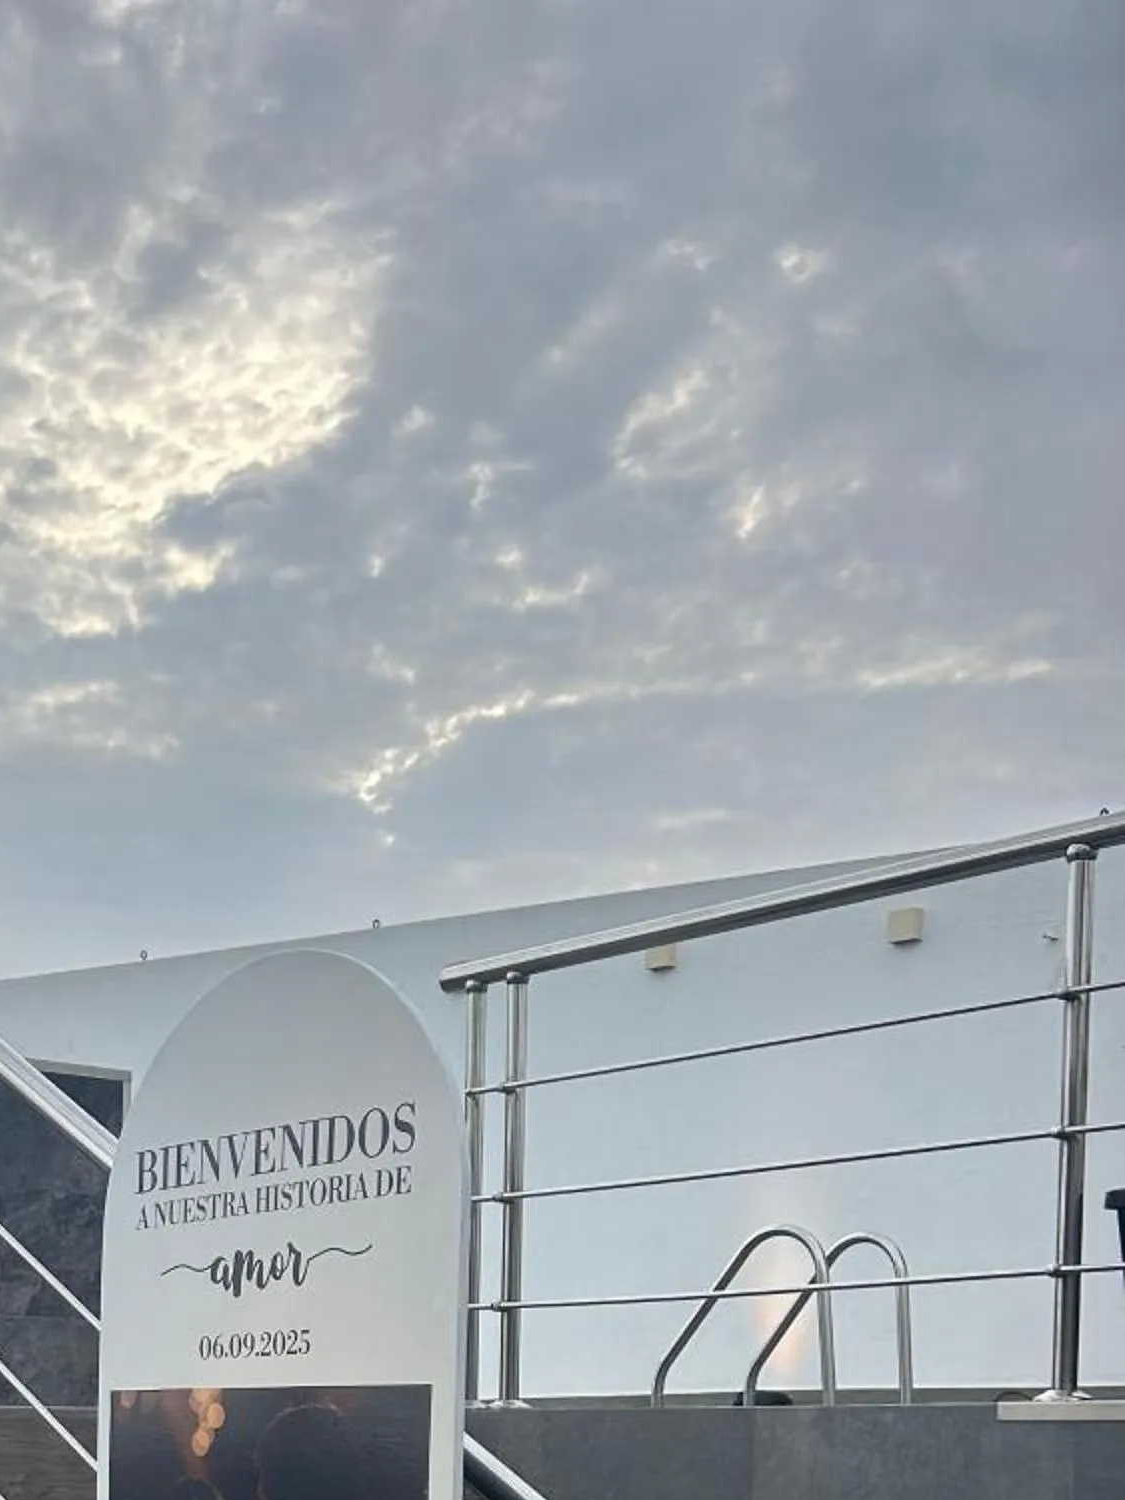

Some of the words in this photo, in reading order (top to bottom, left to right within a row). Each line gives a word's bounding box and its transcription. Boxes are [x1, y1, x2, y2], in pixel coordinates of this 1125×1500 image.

[134, 1101, 417, 1195] BIENVENIDOS
[135, 1202, 149, 1231] A
[154, 1190, 250, 1228] NUESTRA
[255, 1172, 369, 1214] HISTORIA
[374, 1165, 412, 1199] DE
[160, 1241, 373, 1298] amor
[198, 1328, 311, 1360] 06.09.2025
